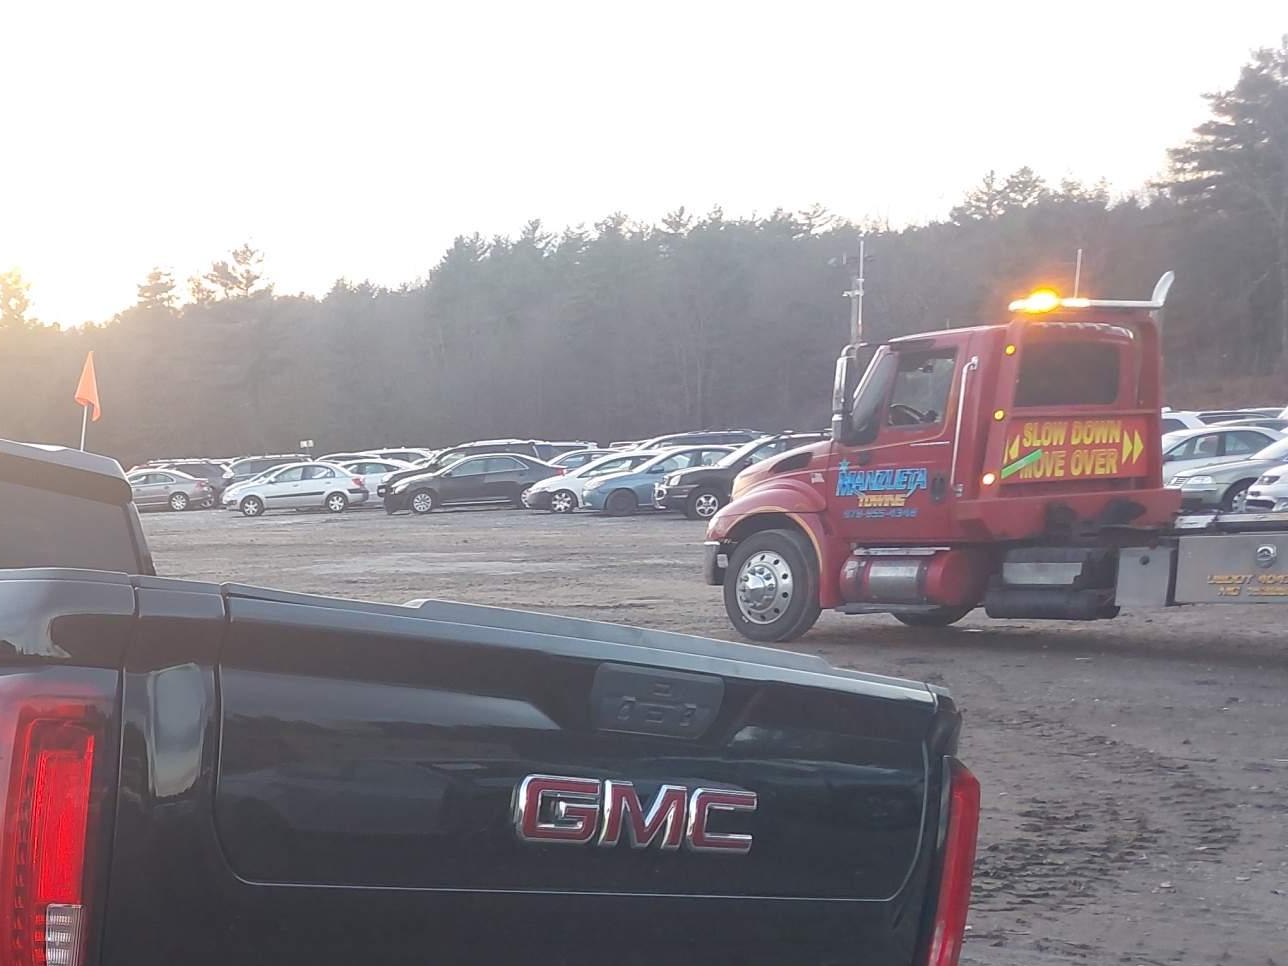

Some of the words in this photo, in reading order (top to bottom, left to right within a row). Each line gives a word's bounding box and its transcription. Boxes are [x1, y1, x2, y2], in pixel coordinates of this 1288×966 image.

[1023, 421, 1067, 447] SLOW
[1071, 419, 1122, 446] DOWN
[1071, 448, 1118, 476] OVER
[513, 774, 758, 854] GMC
